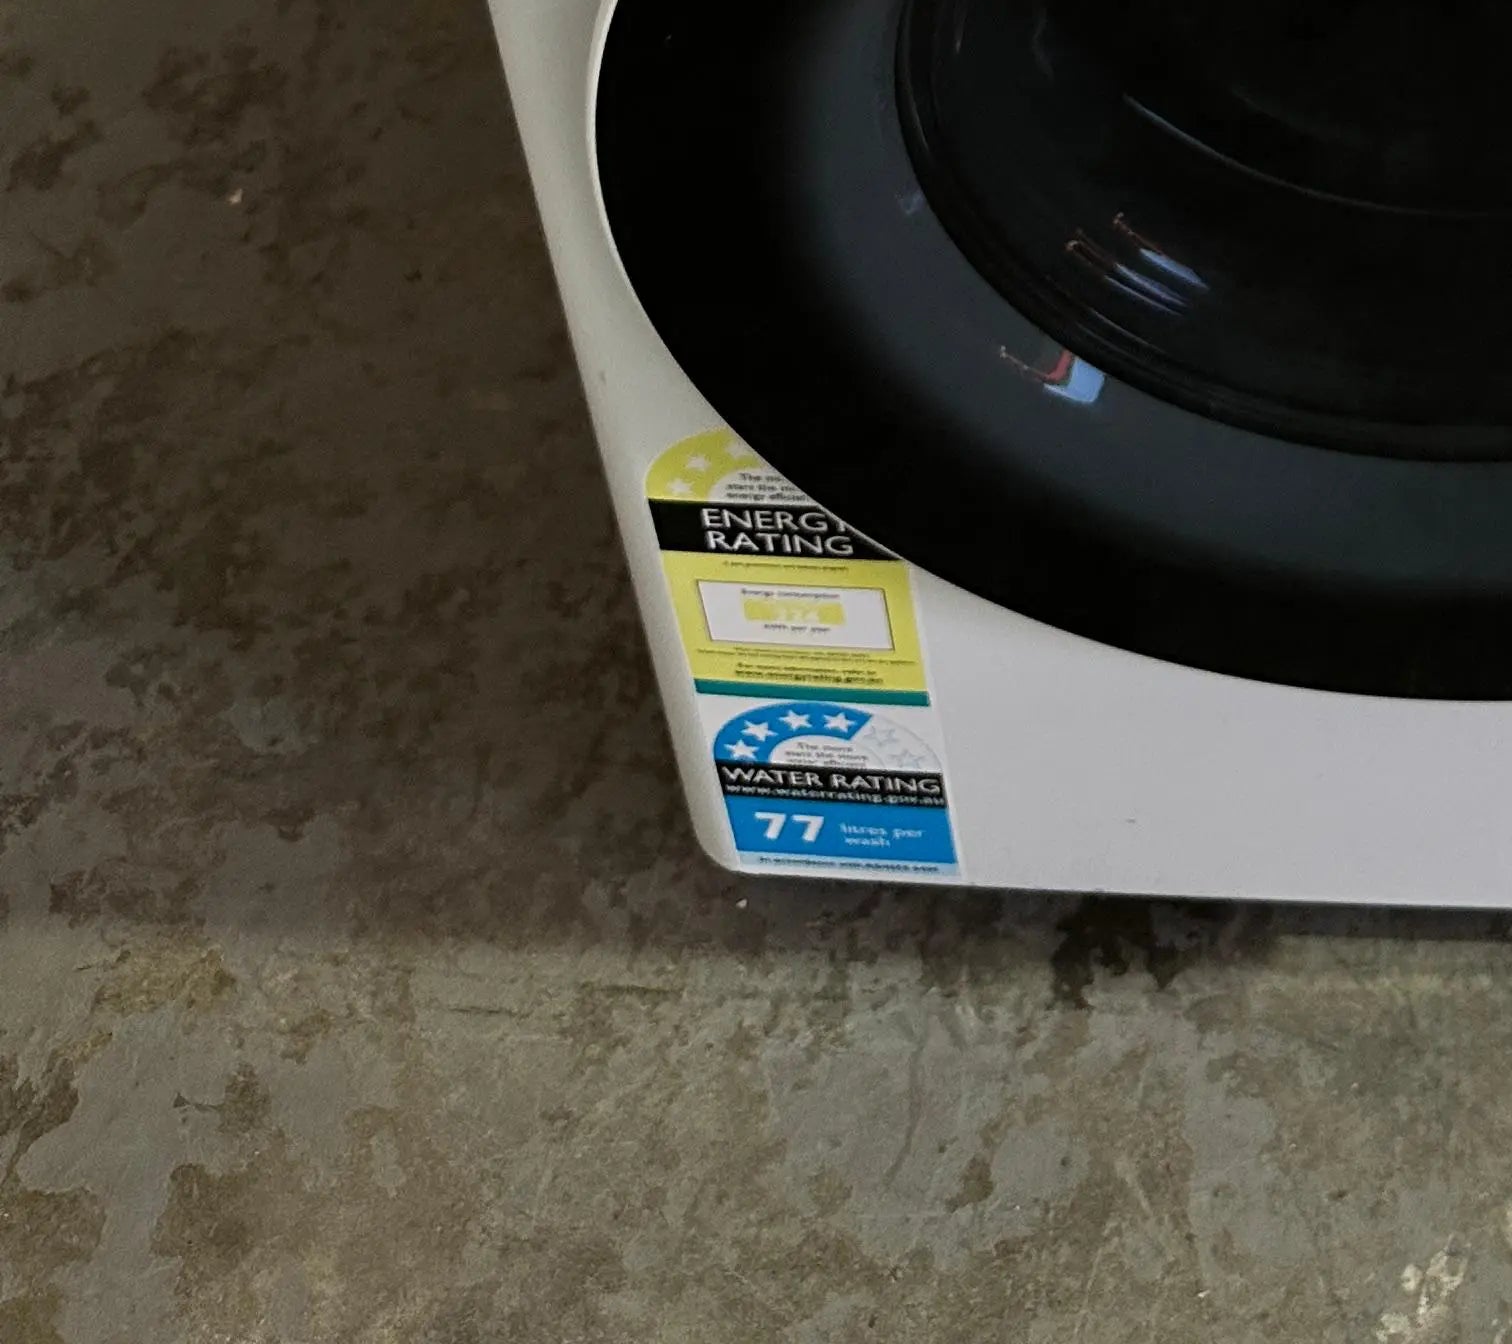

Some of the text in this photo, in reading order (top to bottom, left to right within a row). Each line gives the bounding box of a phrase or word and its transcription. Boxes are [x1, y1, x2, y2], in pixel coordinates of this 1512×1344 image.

[702, 508, 845, 533] ENERG
[705, 530, 854, 556] RATING
[721, 766, 940, 794] WATER RATING
[754, 811, 825, 843] 77
